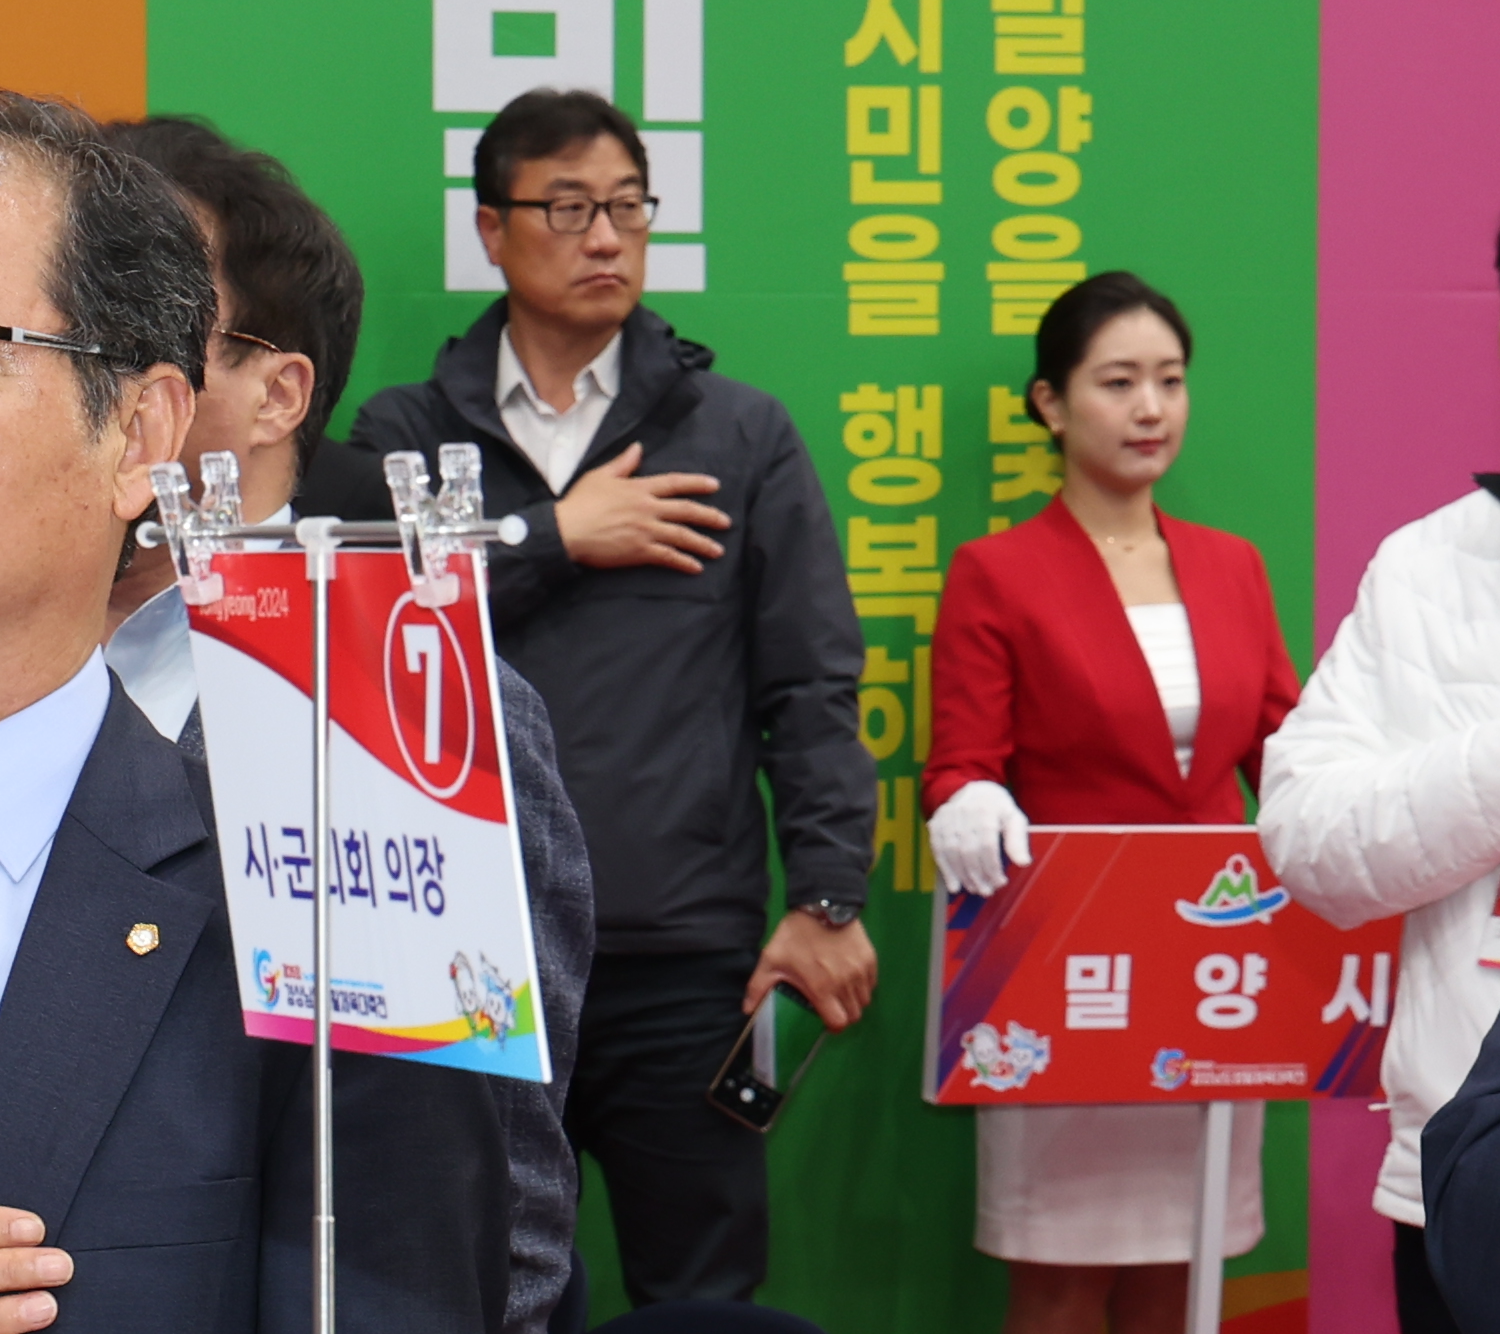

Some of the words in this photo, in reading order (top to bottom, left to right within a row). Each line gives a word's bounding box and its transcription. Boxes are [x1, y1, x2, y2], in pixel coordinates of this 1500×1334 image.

[256, 586, 290, 618] 2024
[402, 623, 443, 765] 7
[384, 833, 446, 917] 의장
